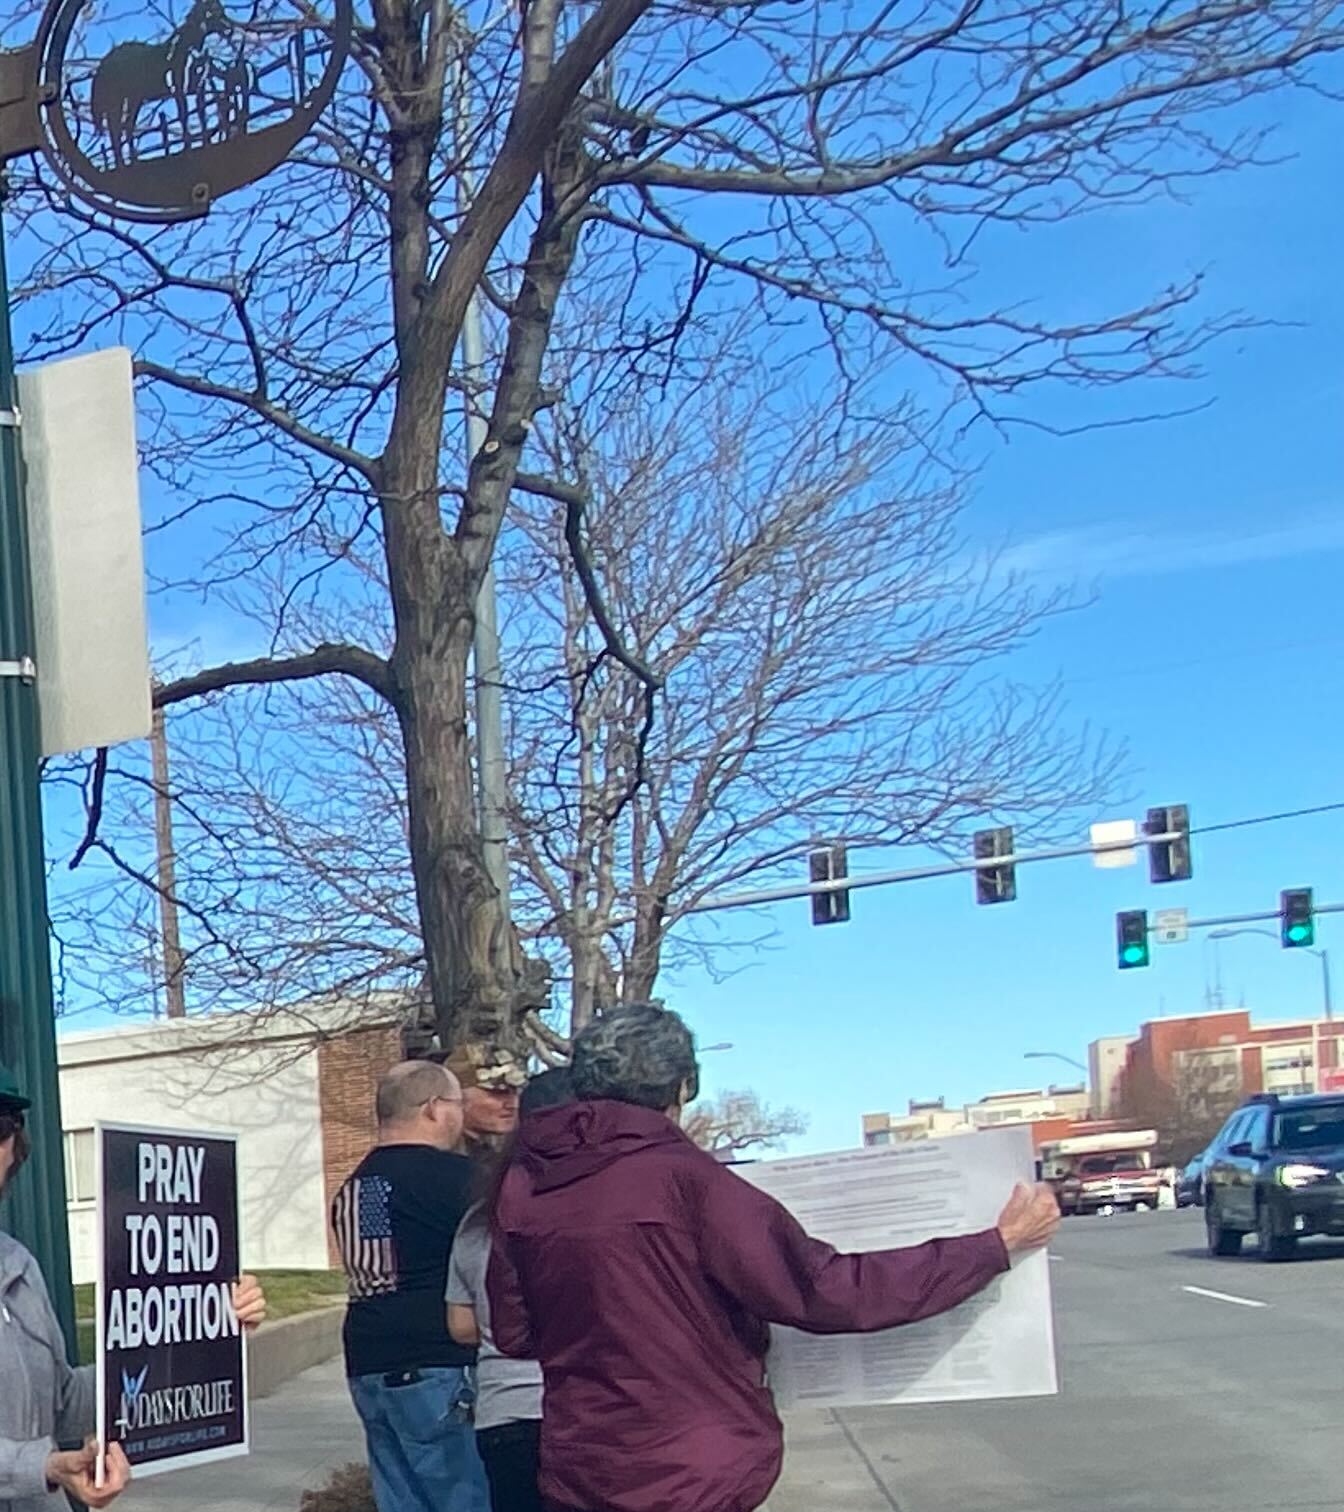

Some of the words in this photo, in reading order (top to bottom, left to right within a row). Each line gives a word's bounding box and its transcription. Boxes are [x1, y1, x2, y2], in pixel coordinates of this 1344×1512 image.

[138, 1142, 205, 1203] PRAY
[126, 1214, 162, 1275] TO
[167, 1214, 219, 1274] END
[106, 1282, 239, 1350] ABORTION
